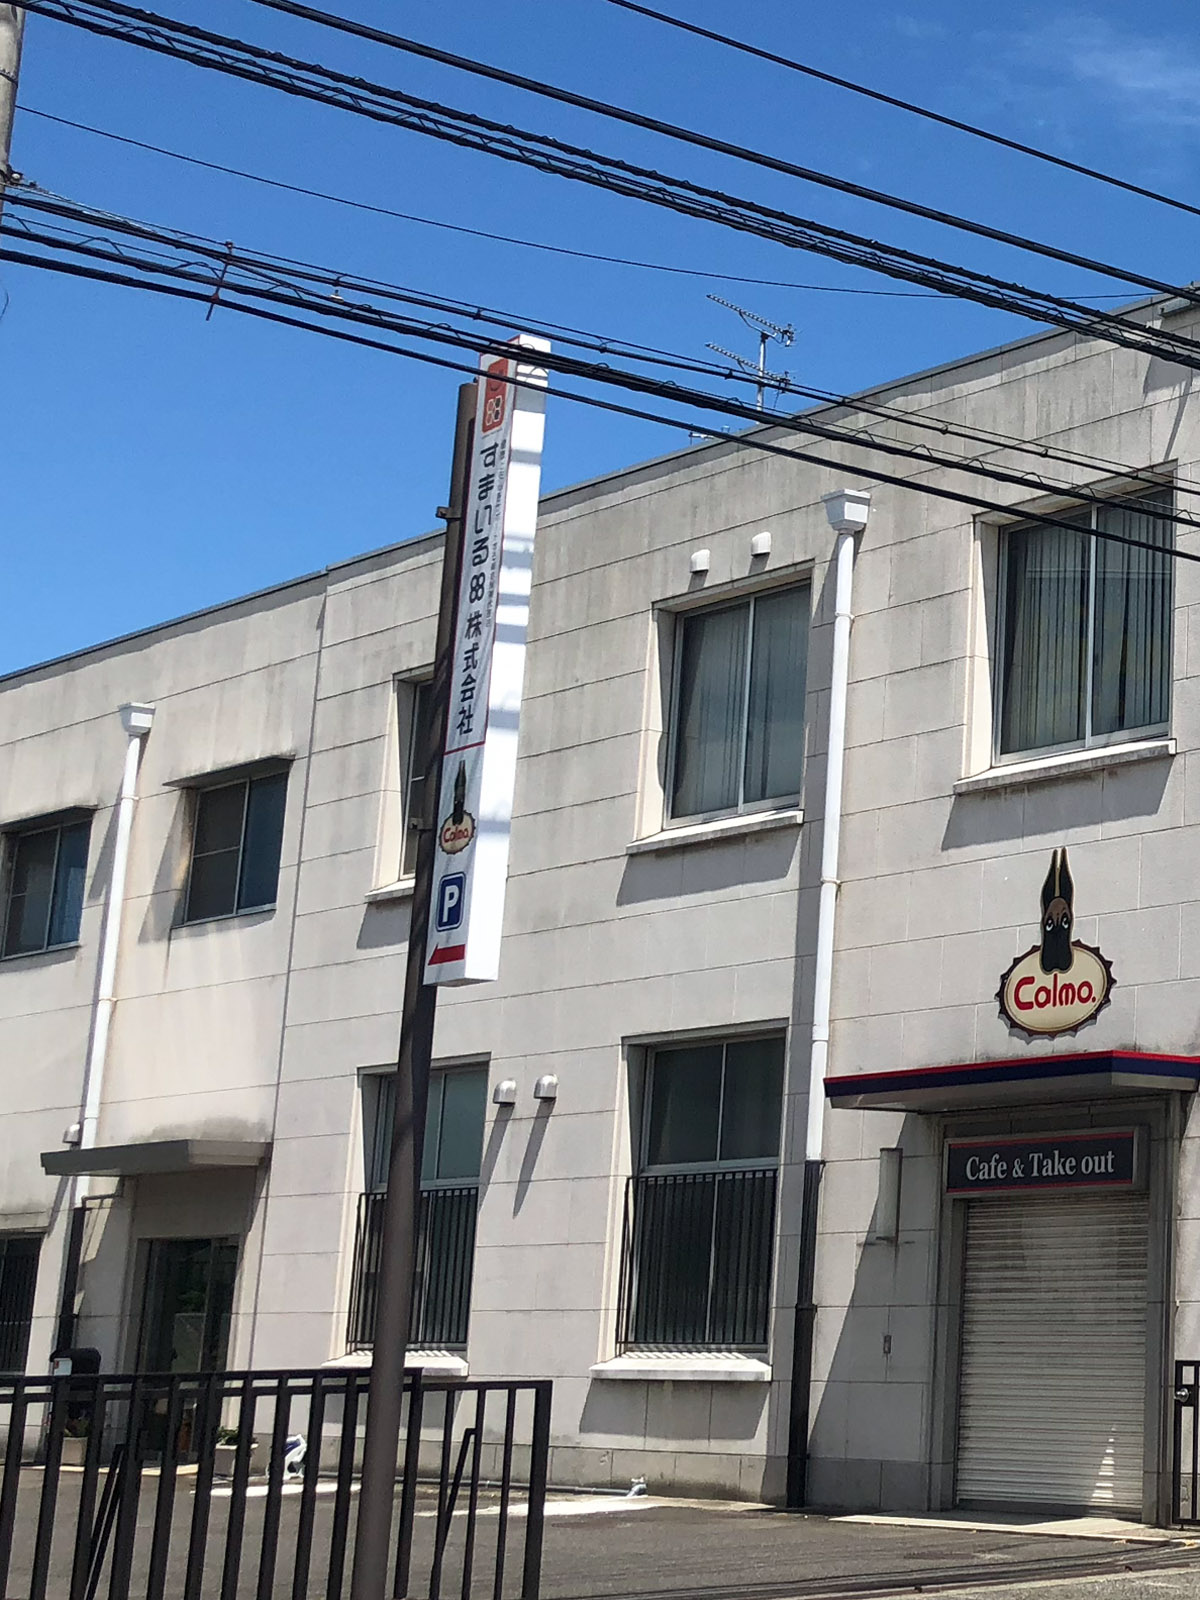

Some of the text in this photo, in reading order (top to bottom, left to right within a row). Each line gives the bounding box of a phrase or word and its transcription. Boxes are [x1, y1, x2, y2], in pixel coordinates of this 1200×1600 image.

[442, 884, 460, 916] P
[966, 1150, 1115, 1180] Cafe & Take out
